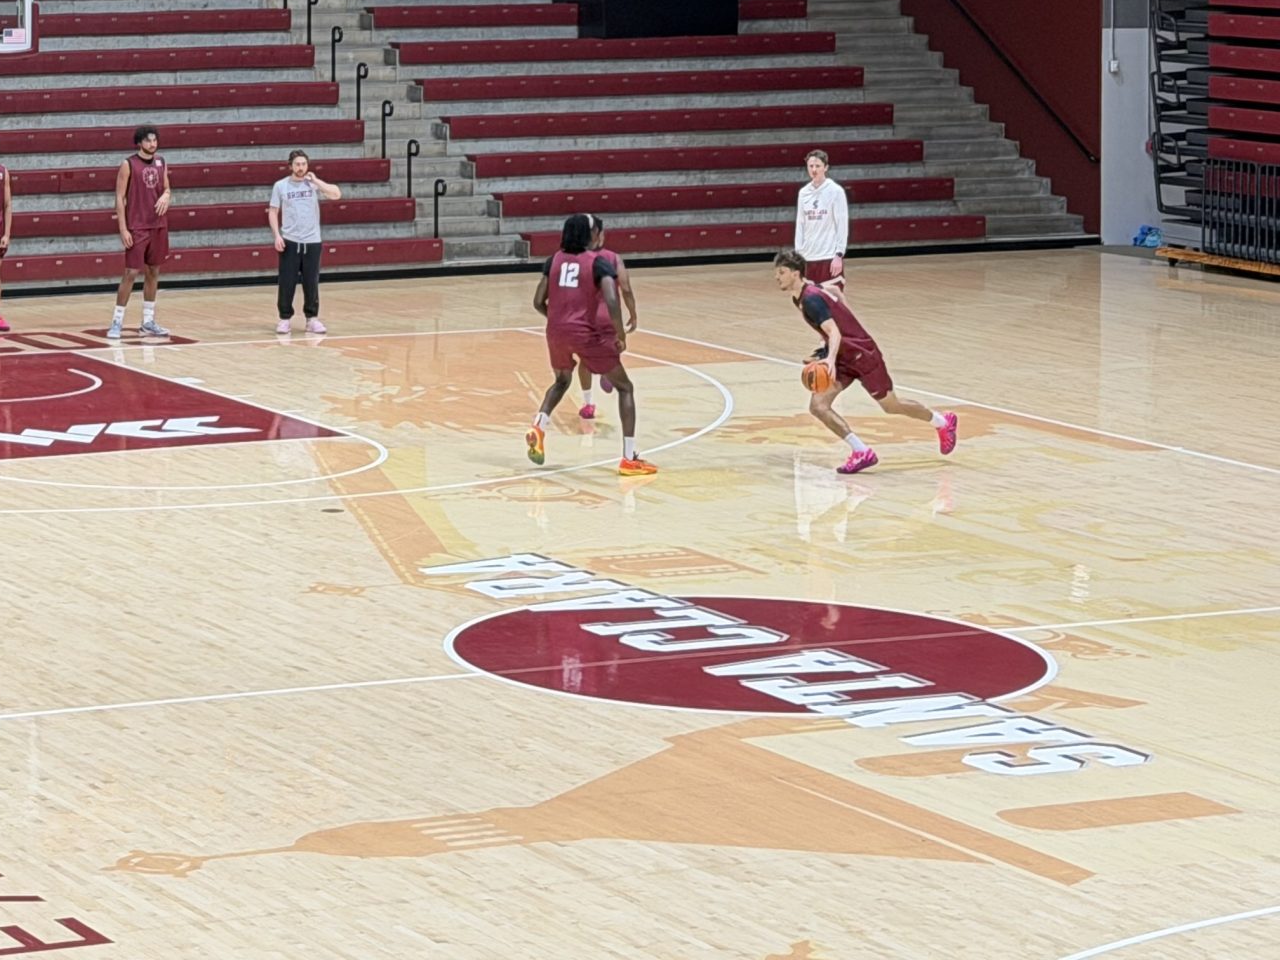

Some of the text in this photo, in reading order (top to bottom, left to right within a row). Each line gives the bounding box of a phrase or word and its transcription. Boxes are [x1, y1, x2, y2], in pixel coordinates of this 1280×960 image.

[559, 262, 580, 288] 12
[418, 552, 1155, 776] SANTA CLARA
